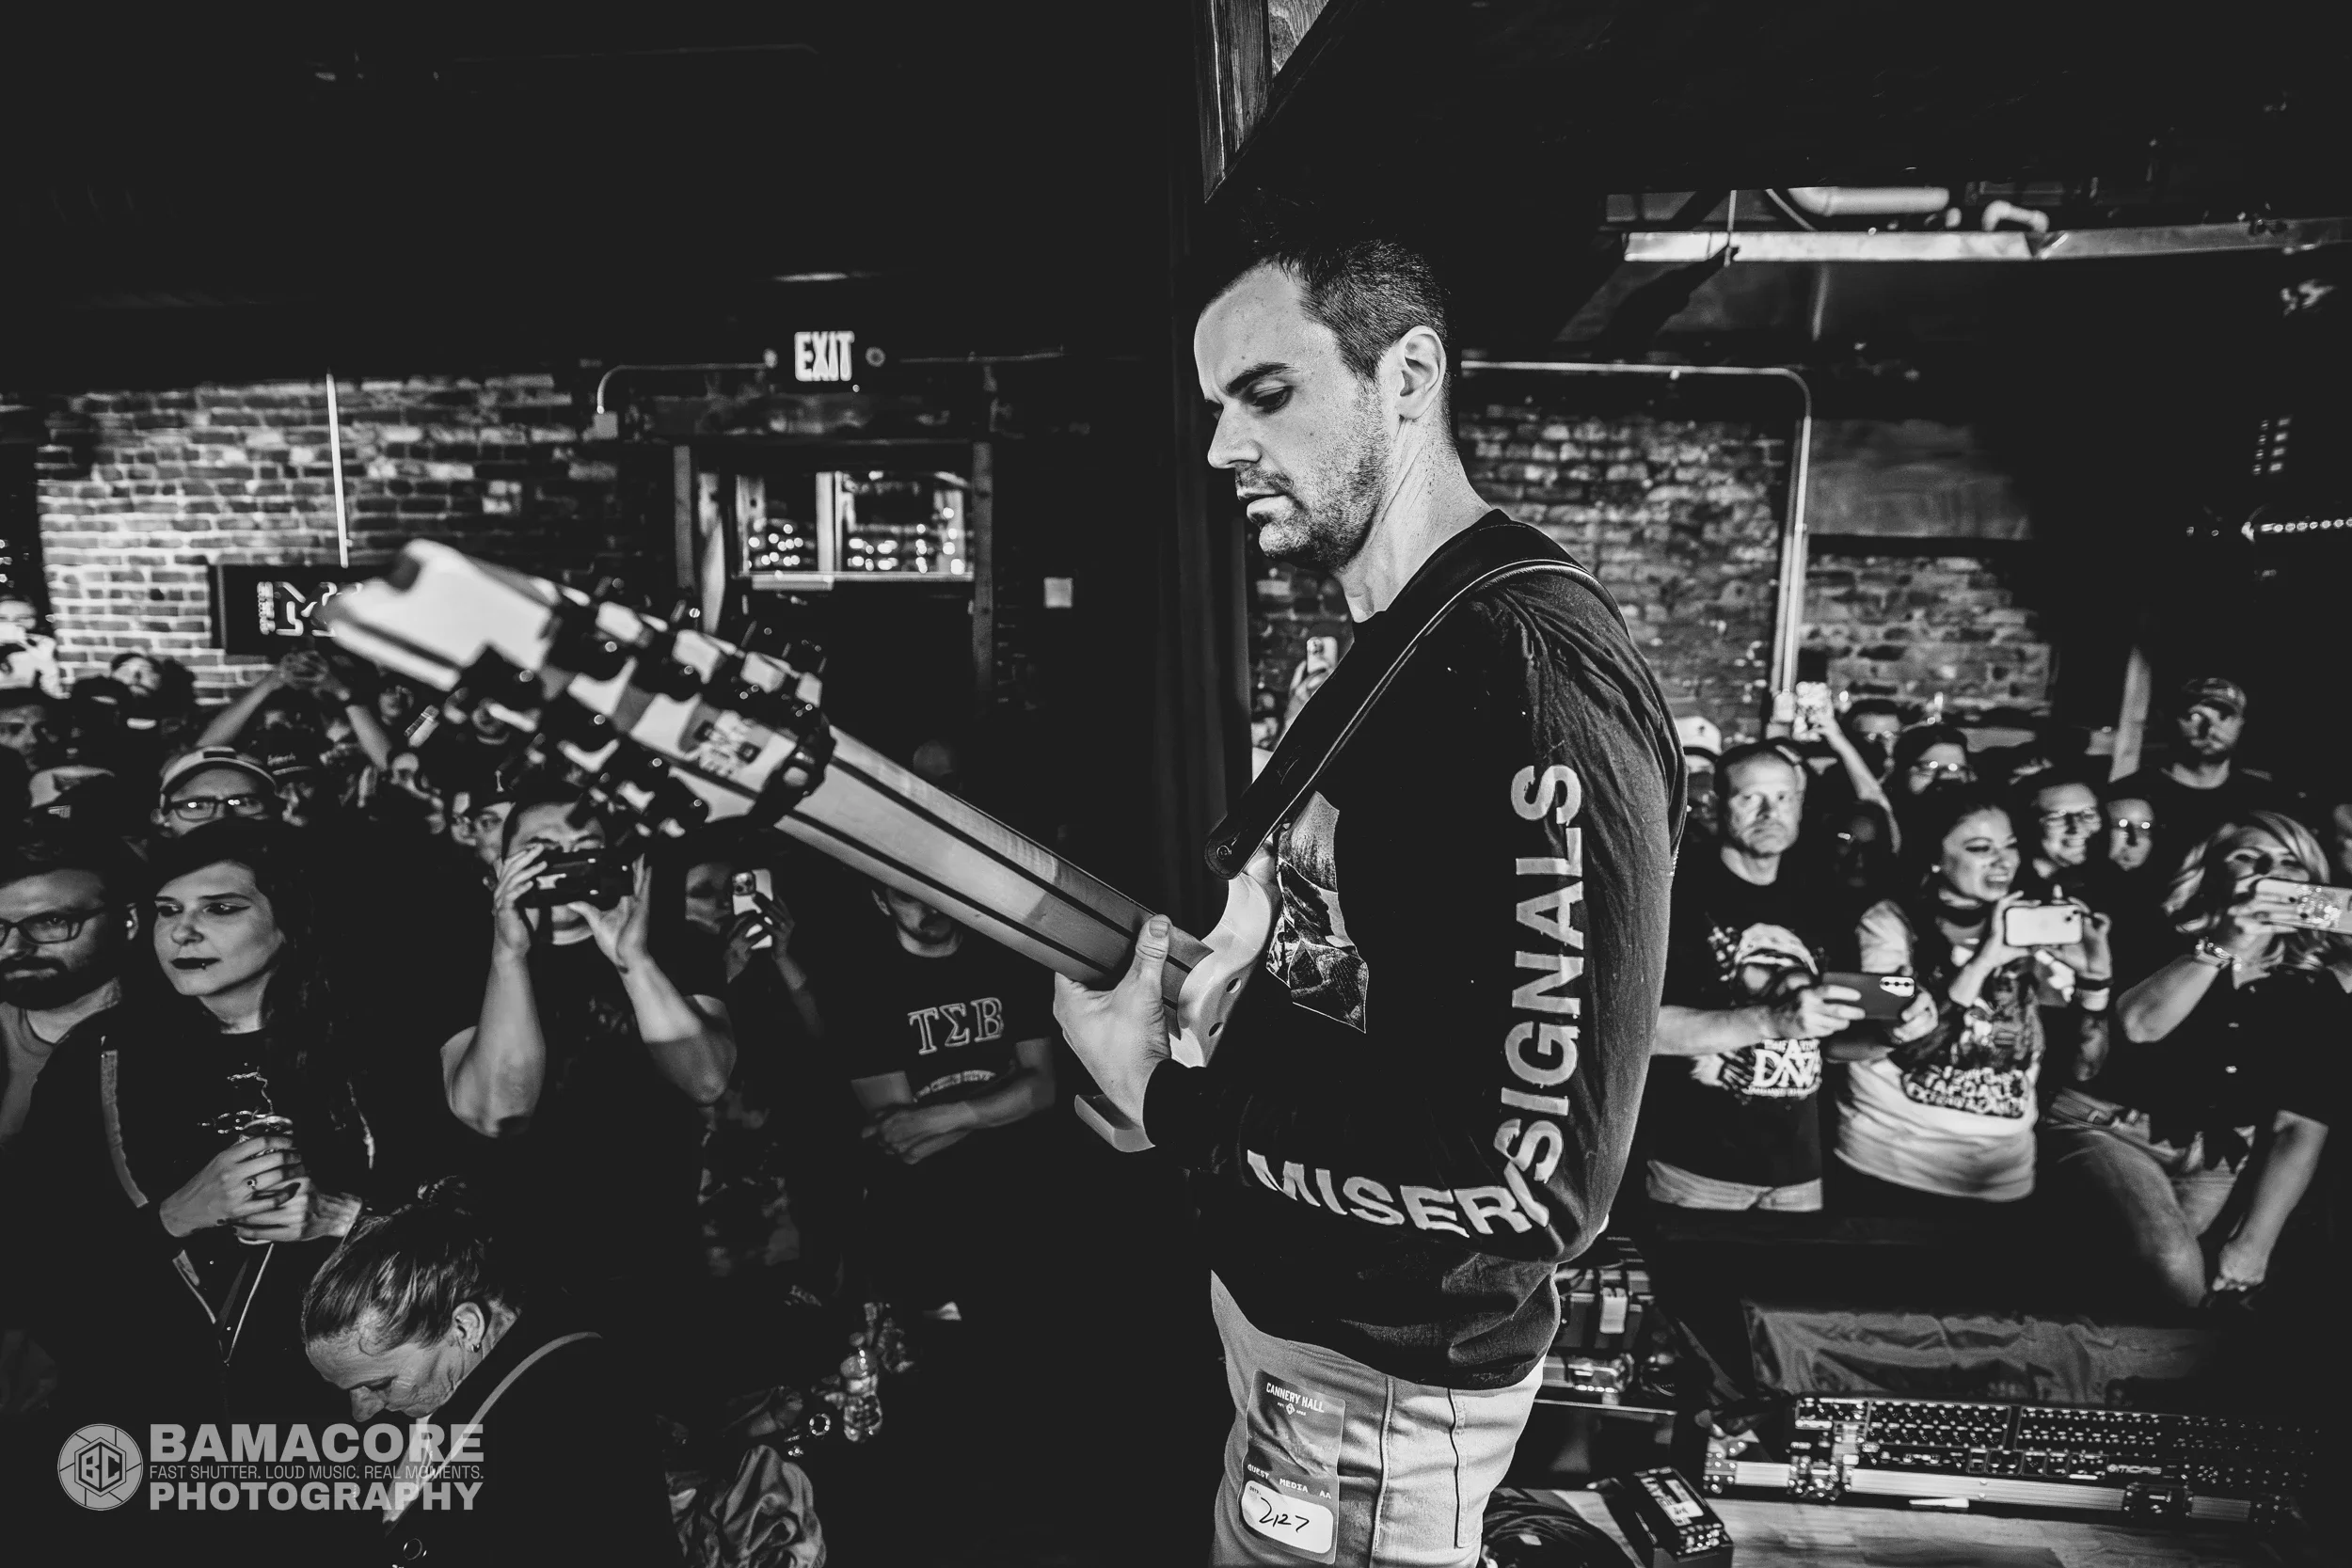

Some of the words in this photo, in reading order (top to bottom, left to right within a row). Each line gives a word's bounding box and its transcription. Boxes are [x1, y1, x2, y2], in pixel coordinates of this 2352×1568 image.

[794, 330, 855, 382] EXIT
[1493, 765, 1584, 1184] SIGNALS
[1266, 1382, 1301, 1404] CANNERY
[1301, 1396, 1325, 1413] HALL
[1248, 1464, 1270, 1480] GUEST
[1279, 1478, 1309, 1493] MEDIA
[1319, 1490, 1332, 1499] AA
